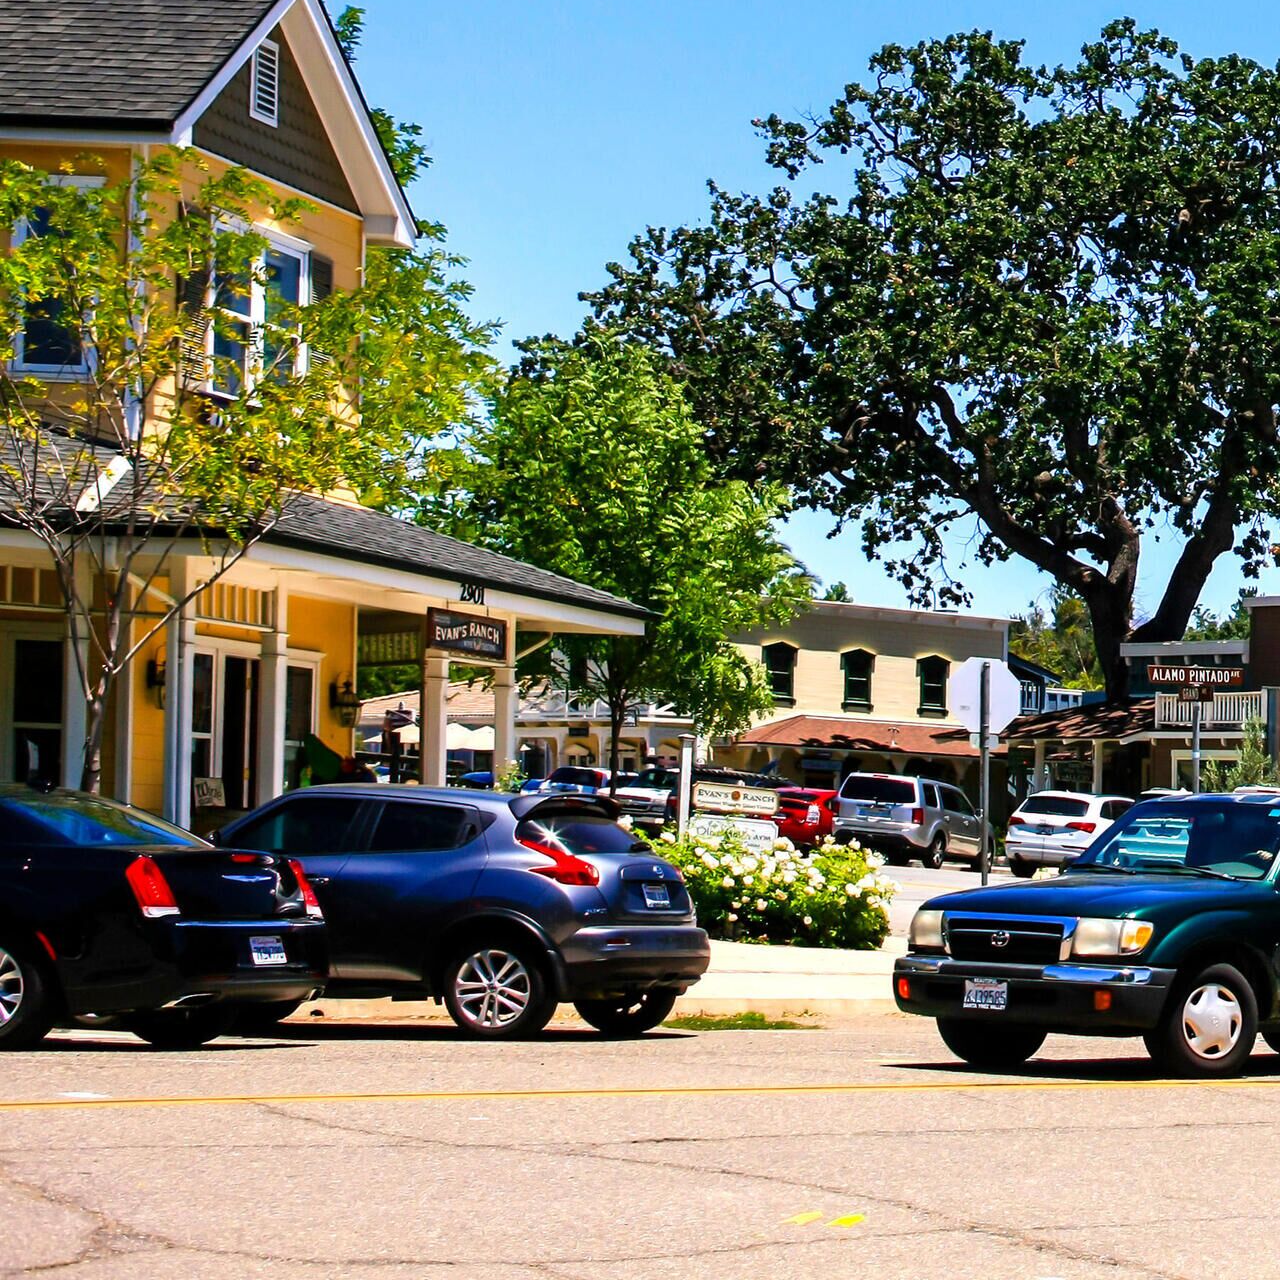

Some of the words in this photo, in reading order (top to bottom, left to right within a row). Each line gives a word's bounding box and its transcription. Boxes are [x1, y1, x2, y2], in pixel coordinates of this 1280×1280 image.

[460, 583, 485, 605] 2901
[435, 625, 468, 641] EVAN'S
[469, 622, 500, 645] RANCH
[1152, 668, 1186, 682] ALAMO
[1189, 669, 1230, 683] PINTADO
[1230, 670, 1241, 678] AVE
[698, 788, 731, 799] EVAN'S
[742, 793, 775, 803] RANCH
